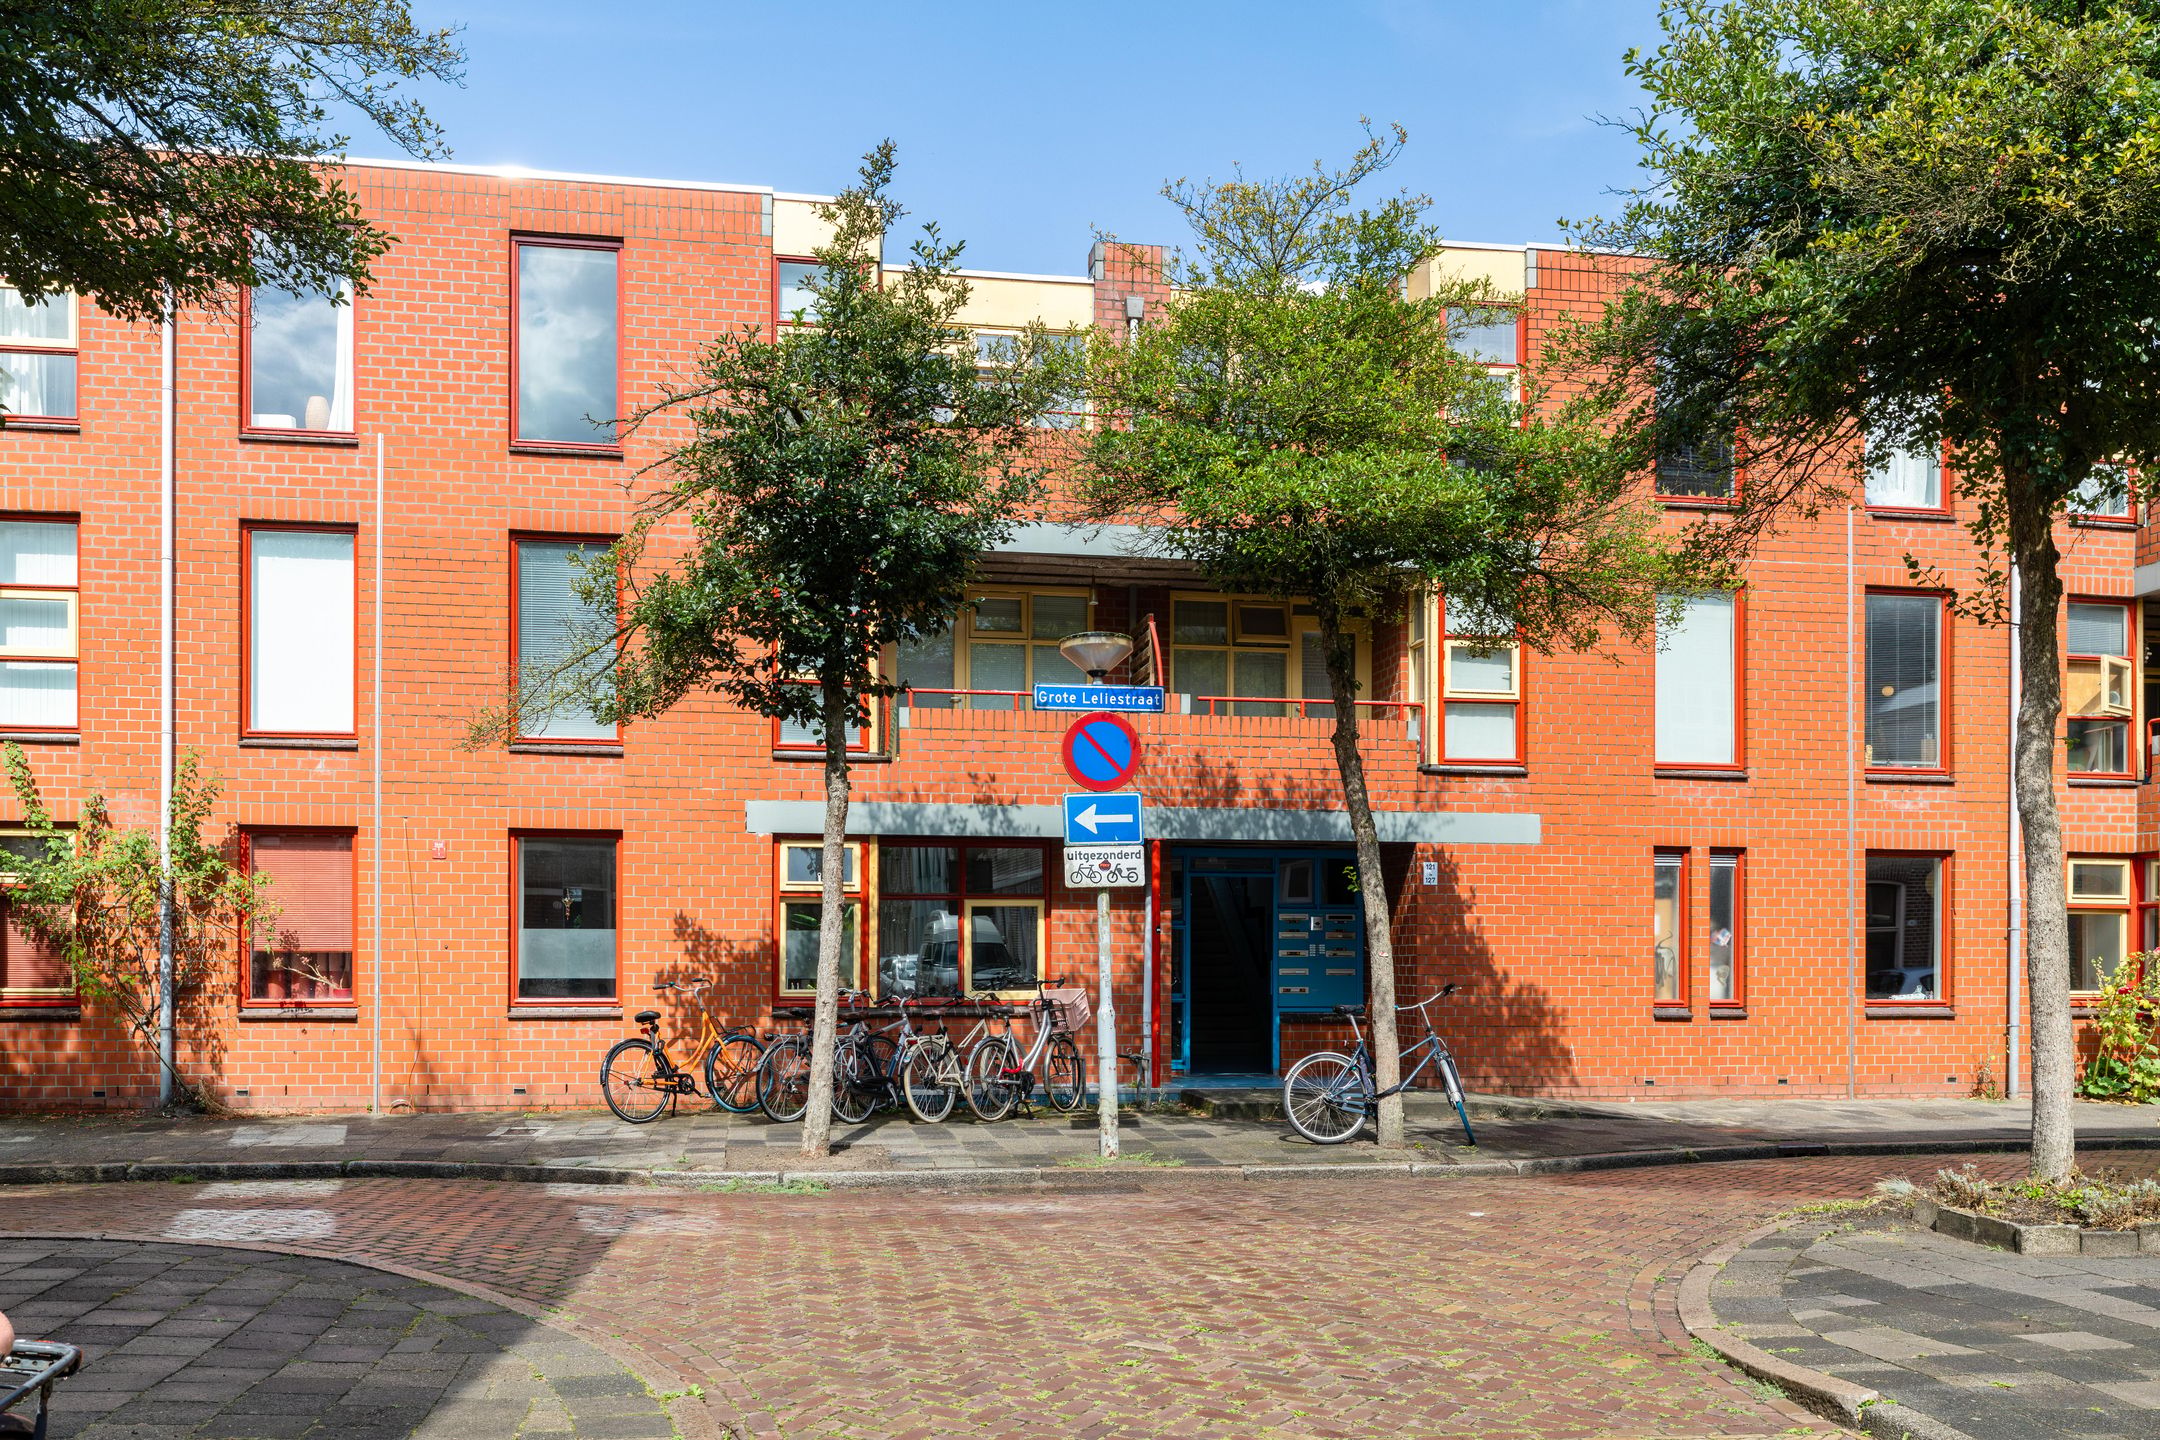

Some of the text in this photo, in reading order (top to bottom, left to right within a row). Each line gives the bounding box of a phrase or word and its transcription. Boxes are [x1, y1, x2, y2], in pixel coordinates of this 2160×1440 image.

[1038, 690, 1160, 705] Grote Leliestraat
[1067, 850, 1141, 863] uitgezonderd
